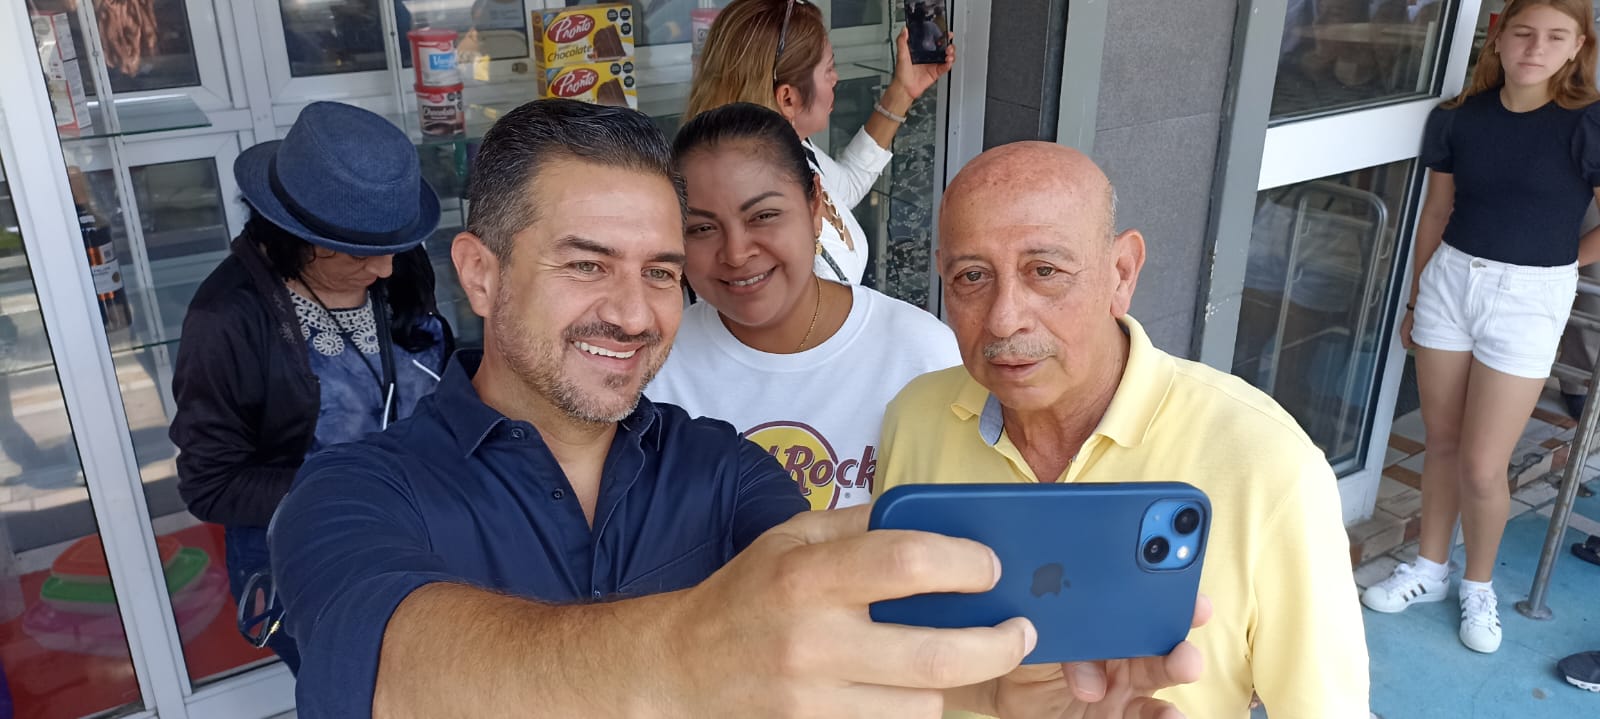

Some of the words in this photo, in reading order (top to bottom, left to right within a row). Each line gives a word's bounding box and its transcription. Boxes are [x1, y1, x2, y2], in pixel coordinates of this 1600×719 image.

[550, 17, 591, 42] Pronto
[547, 44, 592, 62] Chocolate
[554, 71, 595, 96] Pronto
[783, 445, 877, 495] Rock
